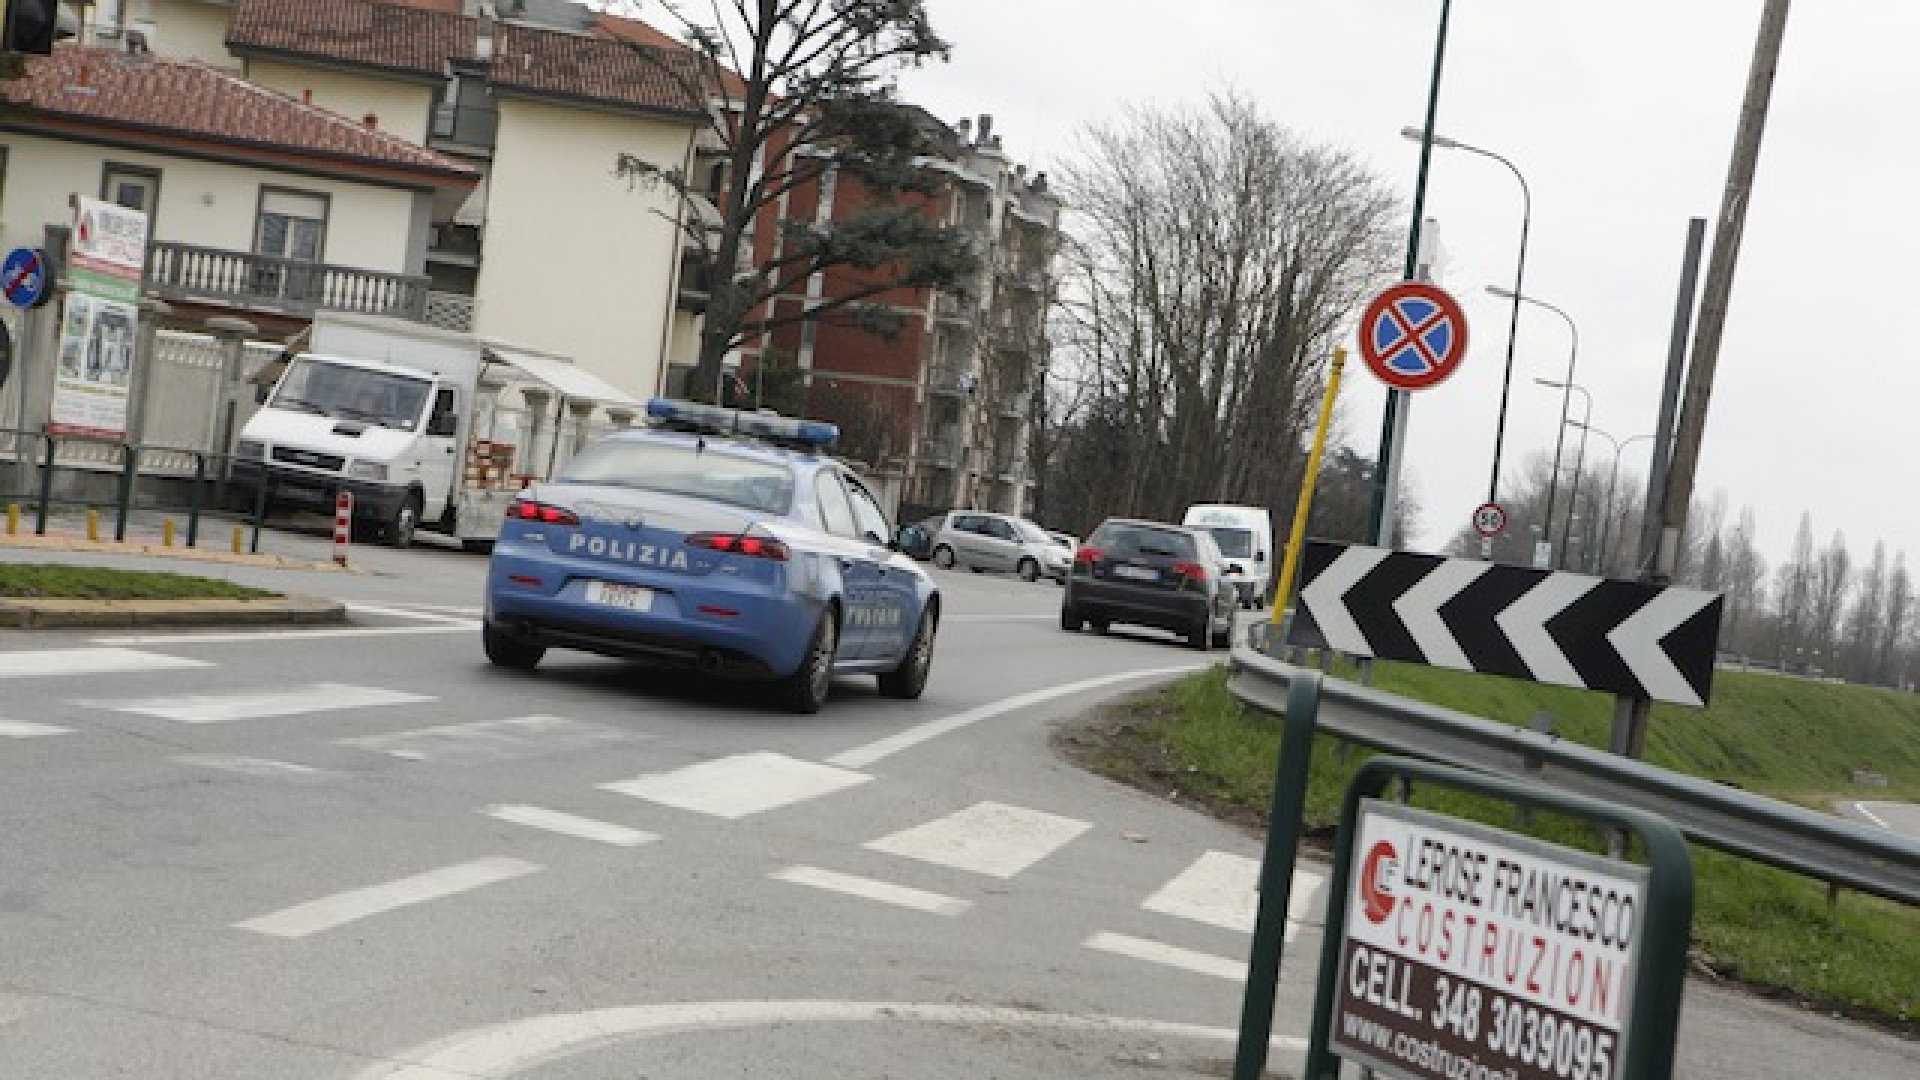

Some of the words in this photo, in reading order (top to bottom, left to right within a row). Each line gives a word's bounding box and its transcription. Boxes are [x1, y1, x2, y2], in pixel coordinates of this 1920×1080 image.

[569, 532, 688, 571] POLIZIA
[1481, 512, 1501, 528] 50
[1403, 833, 1489, 907] LEROSE
[1490, 859, 1635, 951] FRANCESCO
[1350, 947, 1423, 1021] CELL.
[1430, 976, 1483, 1042] 348
[1487, 994, 1614, 1080] 3039095
[1397, 895, 1629, 1023] COSTRUZIONI
